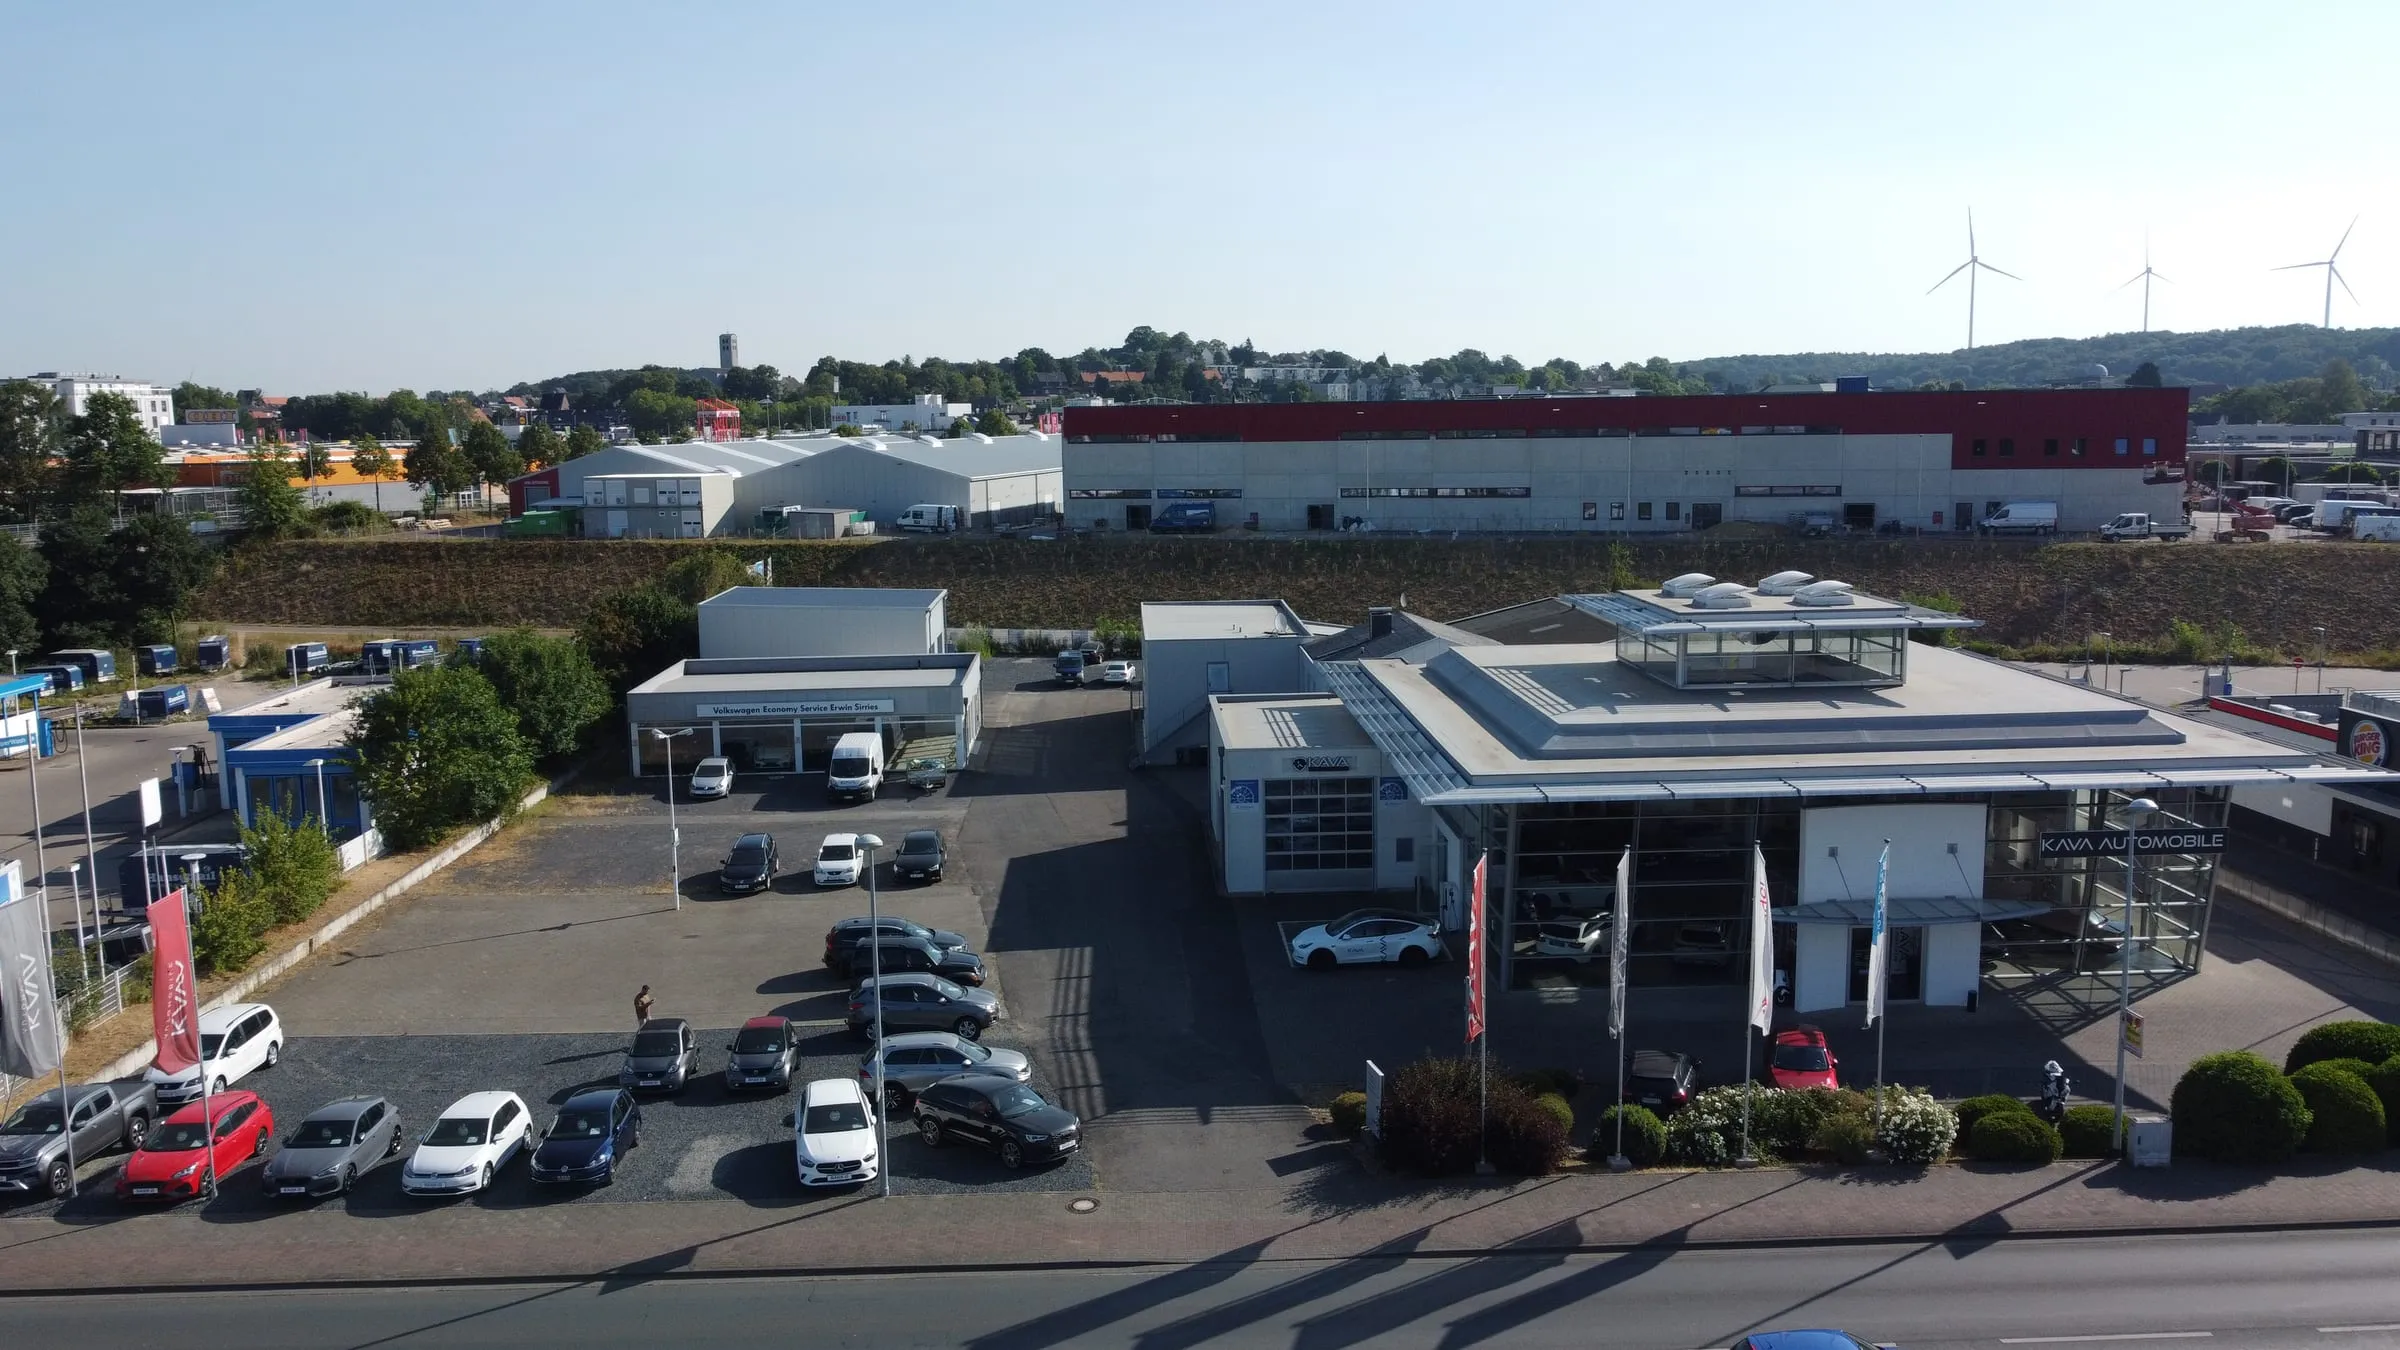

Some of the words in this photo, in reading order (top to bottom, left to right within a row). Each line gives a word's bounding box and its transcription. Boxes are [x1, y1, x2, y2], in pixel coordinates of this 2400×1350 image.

[712, 706, 760, 715] Volkswagen
[763, 705, 798, 714] Economy
[800, 704, 828, 712] Service
[830, 703, 852, 711] Erwin
[854, 703, 878, 711] Sirries
[2354, 741, 2380, 757] KING
[1308, 756, 1349, 767] KAVA
[2042, 837, 2093, 851] KAVA
[2098, 834, 2224, 850] AUTOMOBILE
